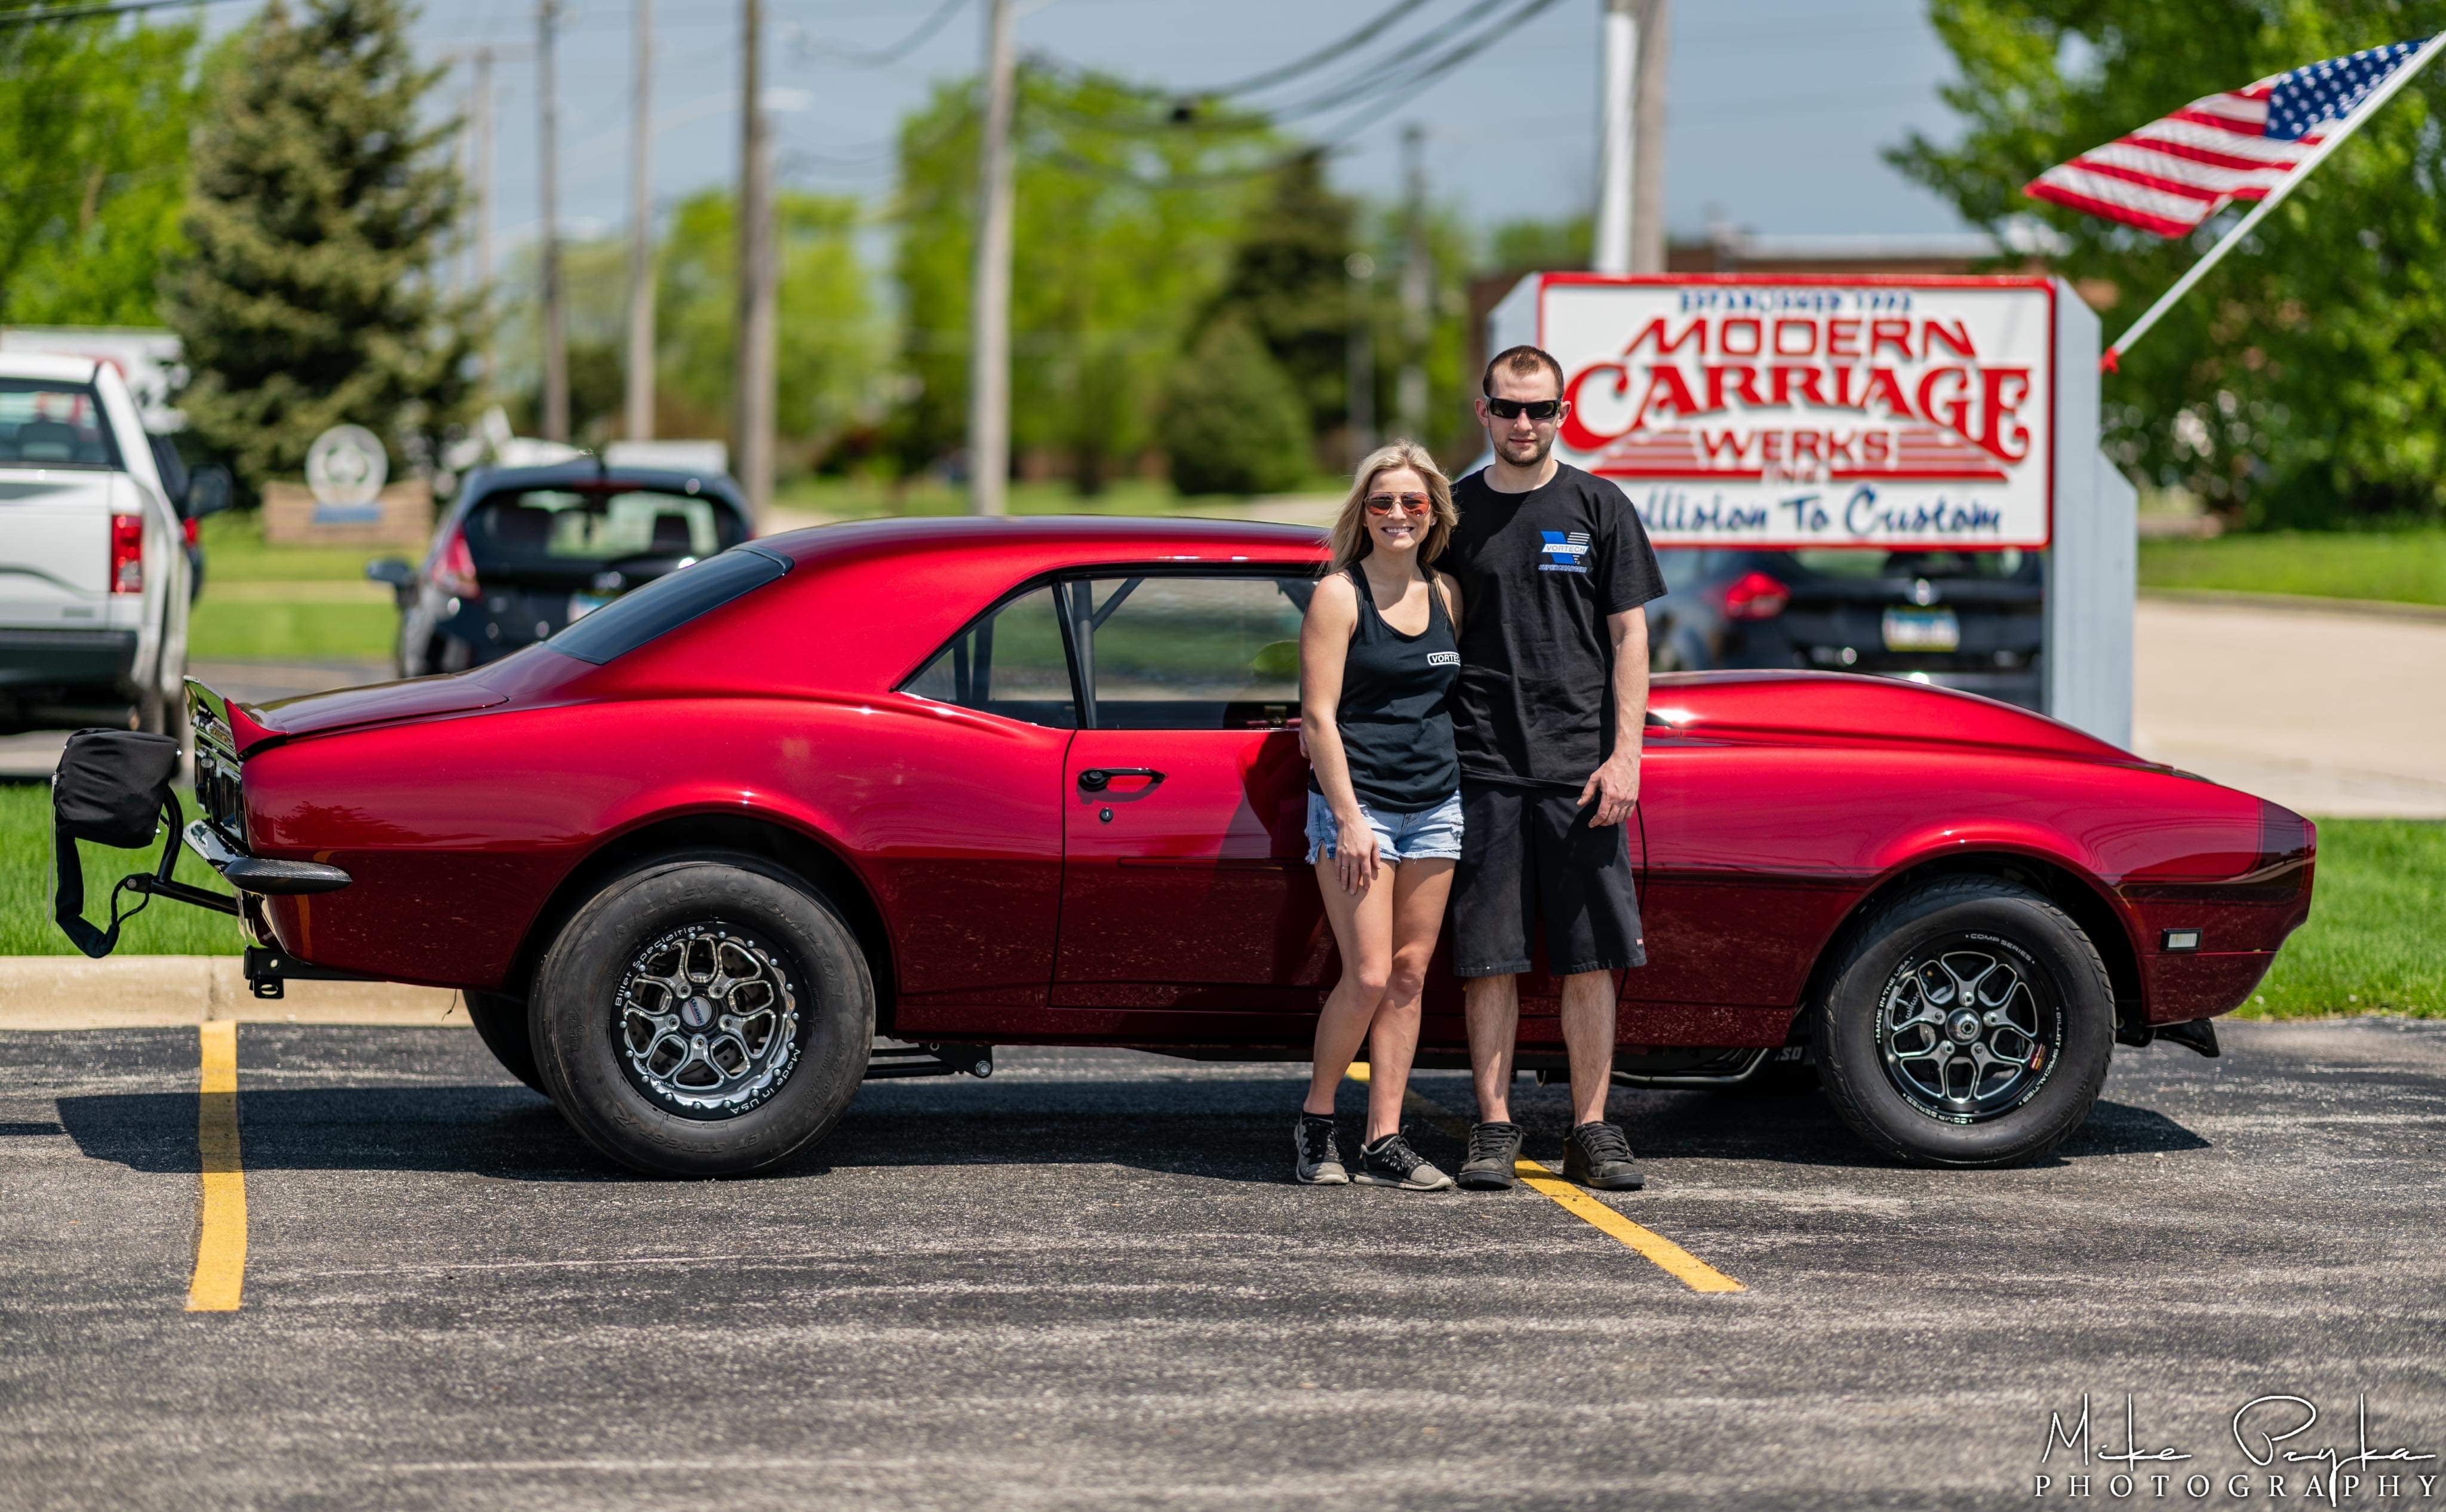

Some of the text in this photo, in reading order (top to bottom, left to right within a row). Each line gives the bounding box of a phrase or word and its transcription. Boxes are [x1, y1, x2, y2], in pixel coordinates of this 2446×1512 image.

[1624, 317, 1977, 359] MODERN
[1559, 362, 2032, 463] CARRIAGE
[1700, 430, 1889, 462] WERKS
[1636, 484, 2002, 534] llision To Custom
[1545, 545, 1586, 554] VORTECH
[1970, 933, 2032, 961] COMP SERIES
[614, 925, 705, 1007] Billet Specialties
[1894, 960, 1910, 977] USA
[1879, 996, 1886, 1008] IN
[1882, 976, 1896, 997] THE
[730, 1049, 801, 1114] Made in USA
[2022, 1048, 2059, 1103] SPECIALTIES
